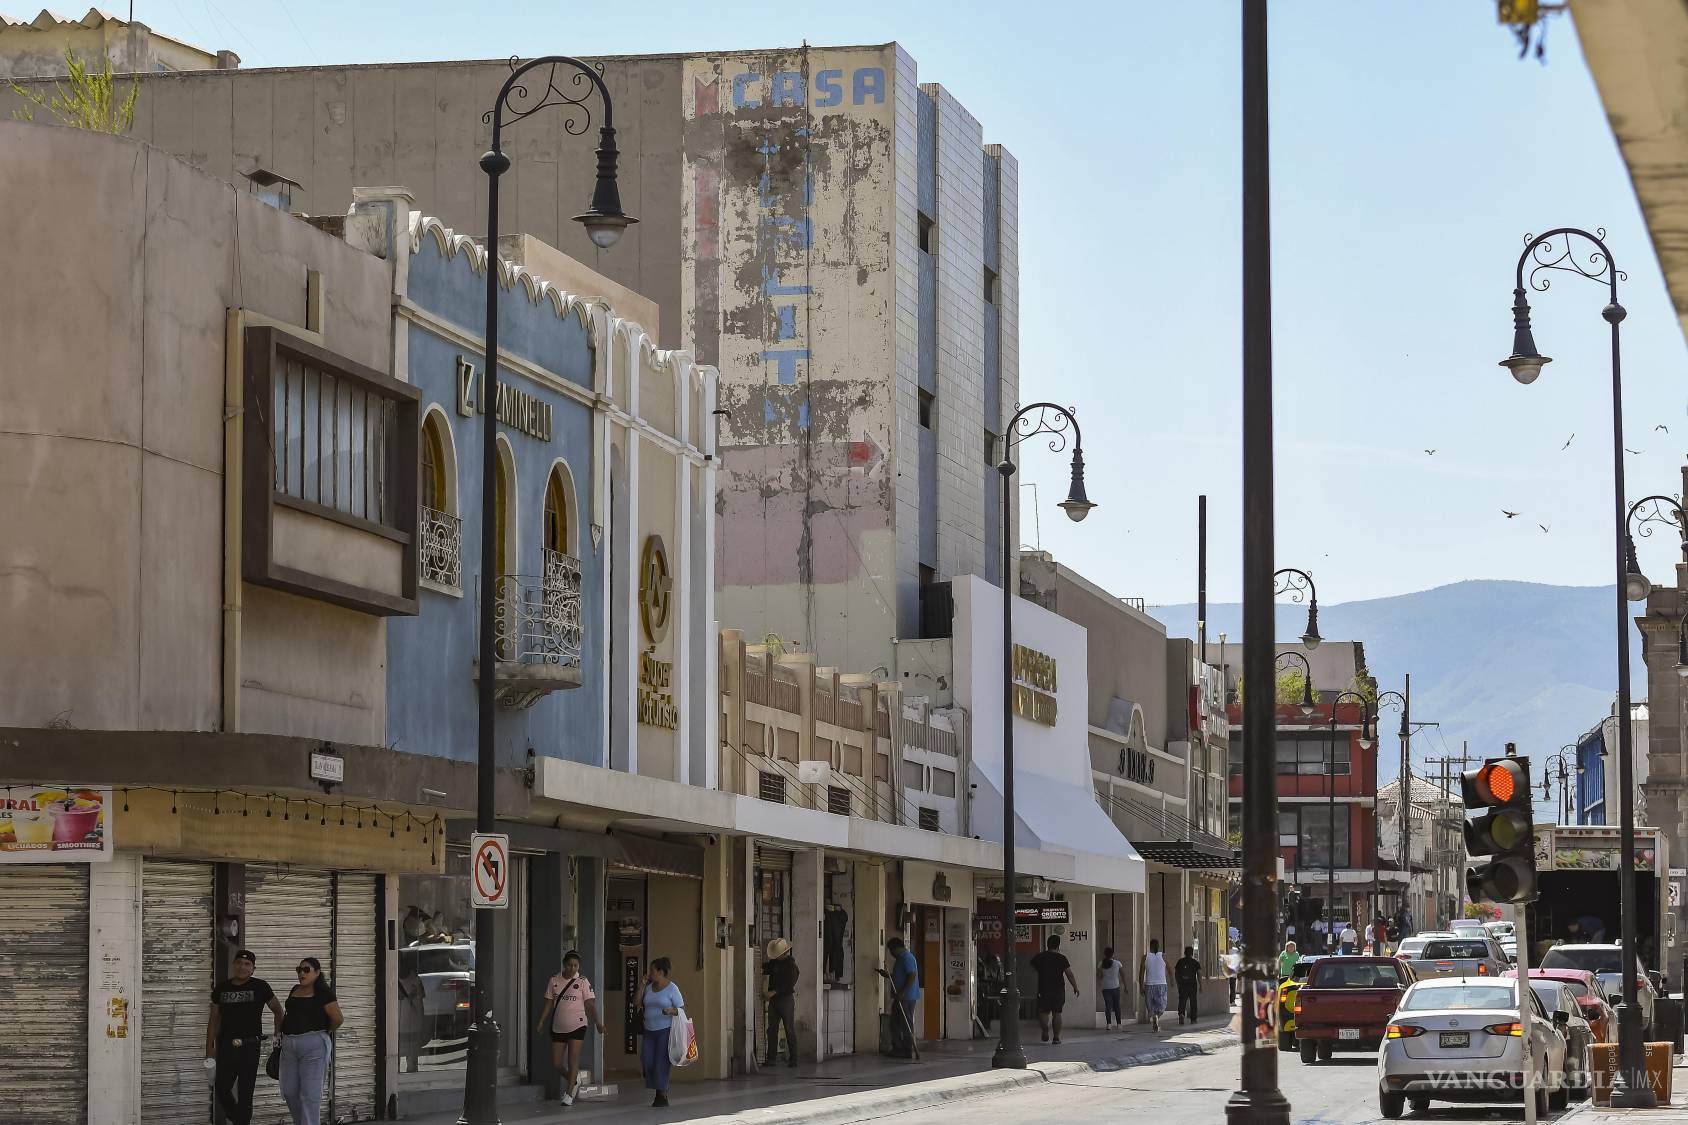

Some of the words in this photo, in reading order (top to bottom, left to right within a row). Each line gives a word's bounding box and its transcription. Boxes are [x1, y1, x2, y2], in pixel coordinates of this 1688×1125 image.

[733, 67, 886, 109] CASA
[57, 842, 101, 850] SMOOTHIES
[1069, 930, 1088, 942] 344
